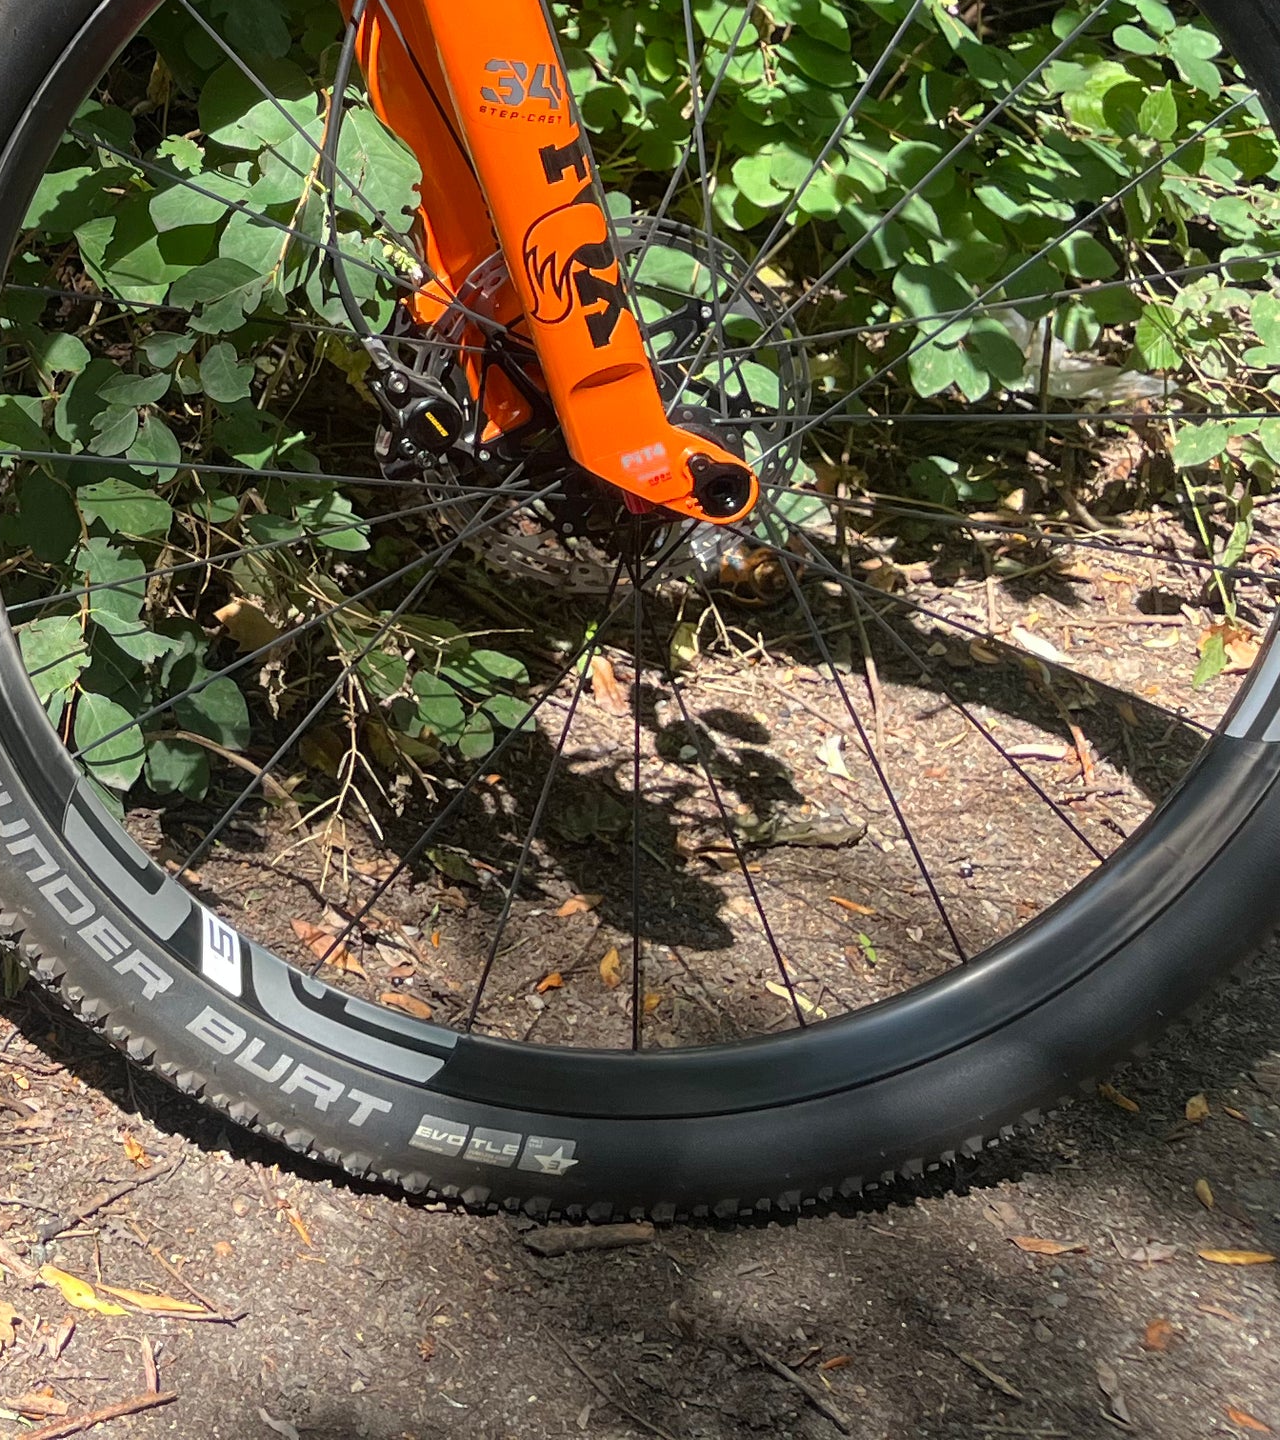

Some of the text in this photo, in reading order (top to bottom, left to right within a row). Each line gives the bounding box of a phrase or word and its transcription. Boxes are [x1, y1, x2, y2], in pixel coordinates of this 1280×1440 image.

[481, 59, 561, 109] 34
[479, 105, 562, 125] STEP-CAST
[184, 1009, 393, 1128] BURT
[415, 1125, 467, 1147] EVO
[470, 1138, 520, 1157] TLE
